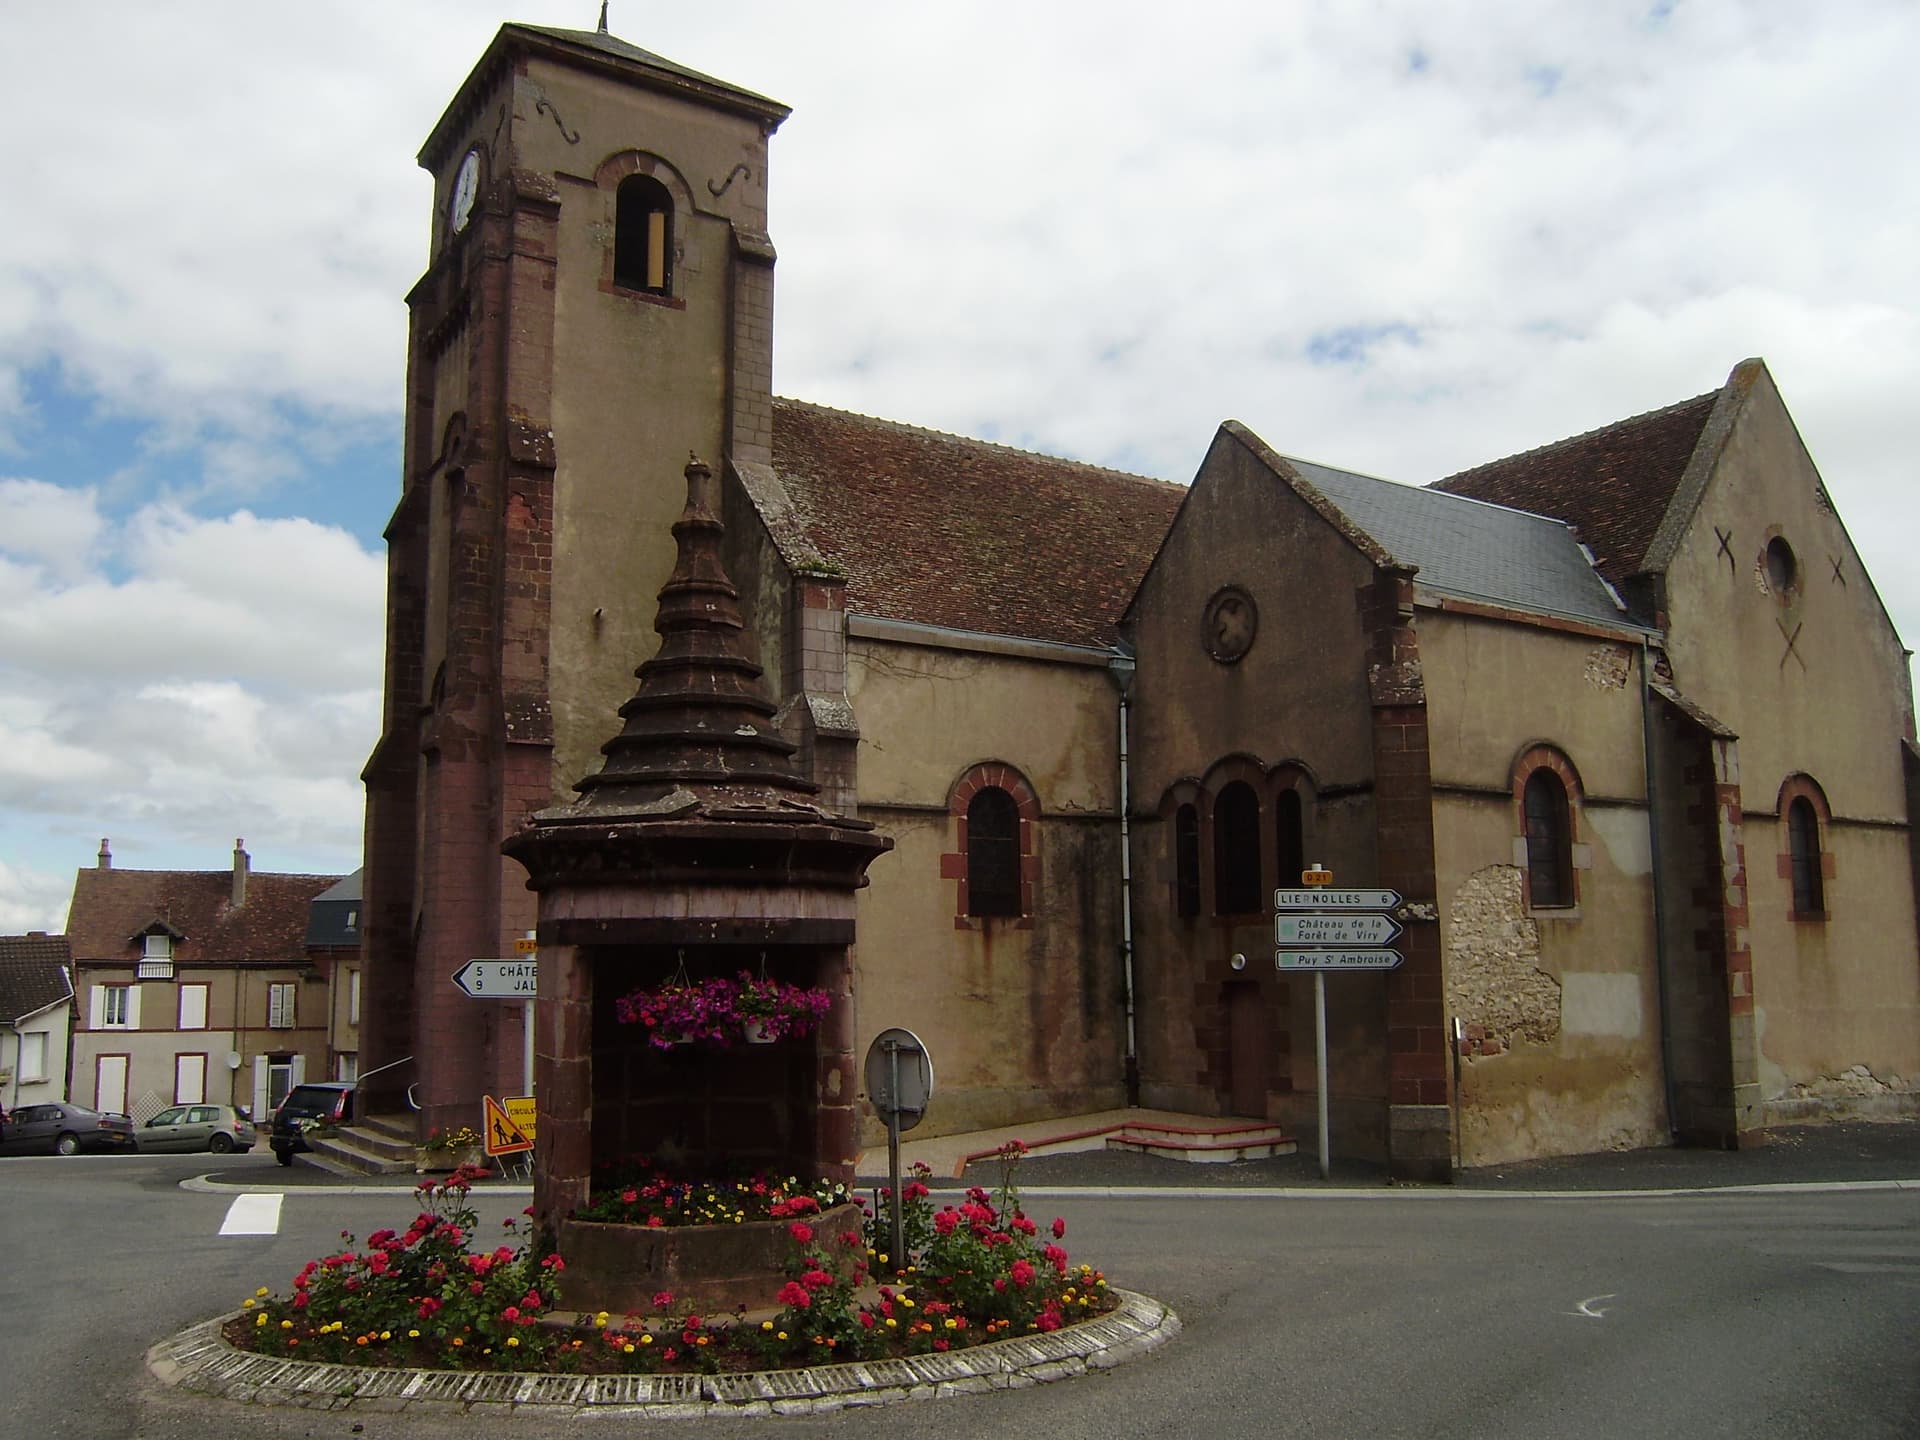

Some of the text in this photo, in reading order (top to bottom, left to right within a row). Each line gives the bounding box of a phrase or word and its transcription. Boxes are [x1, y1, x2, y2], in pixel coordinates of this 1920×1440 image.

[1281, 894, 1388, 904] LIERNOLLES 6
[1298, 918, 1382, 929] Château de la
[1298, 929, 1379, 942] Forêt de Viry
[1298, 955, 1317, 966] Puy
[1340, 954, 1391, 964] Ambroise
[476, 966, 483, 977] 5
[476, 980, 483, 990] 9
